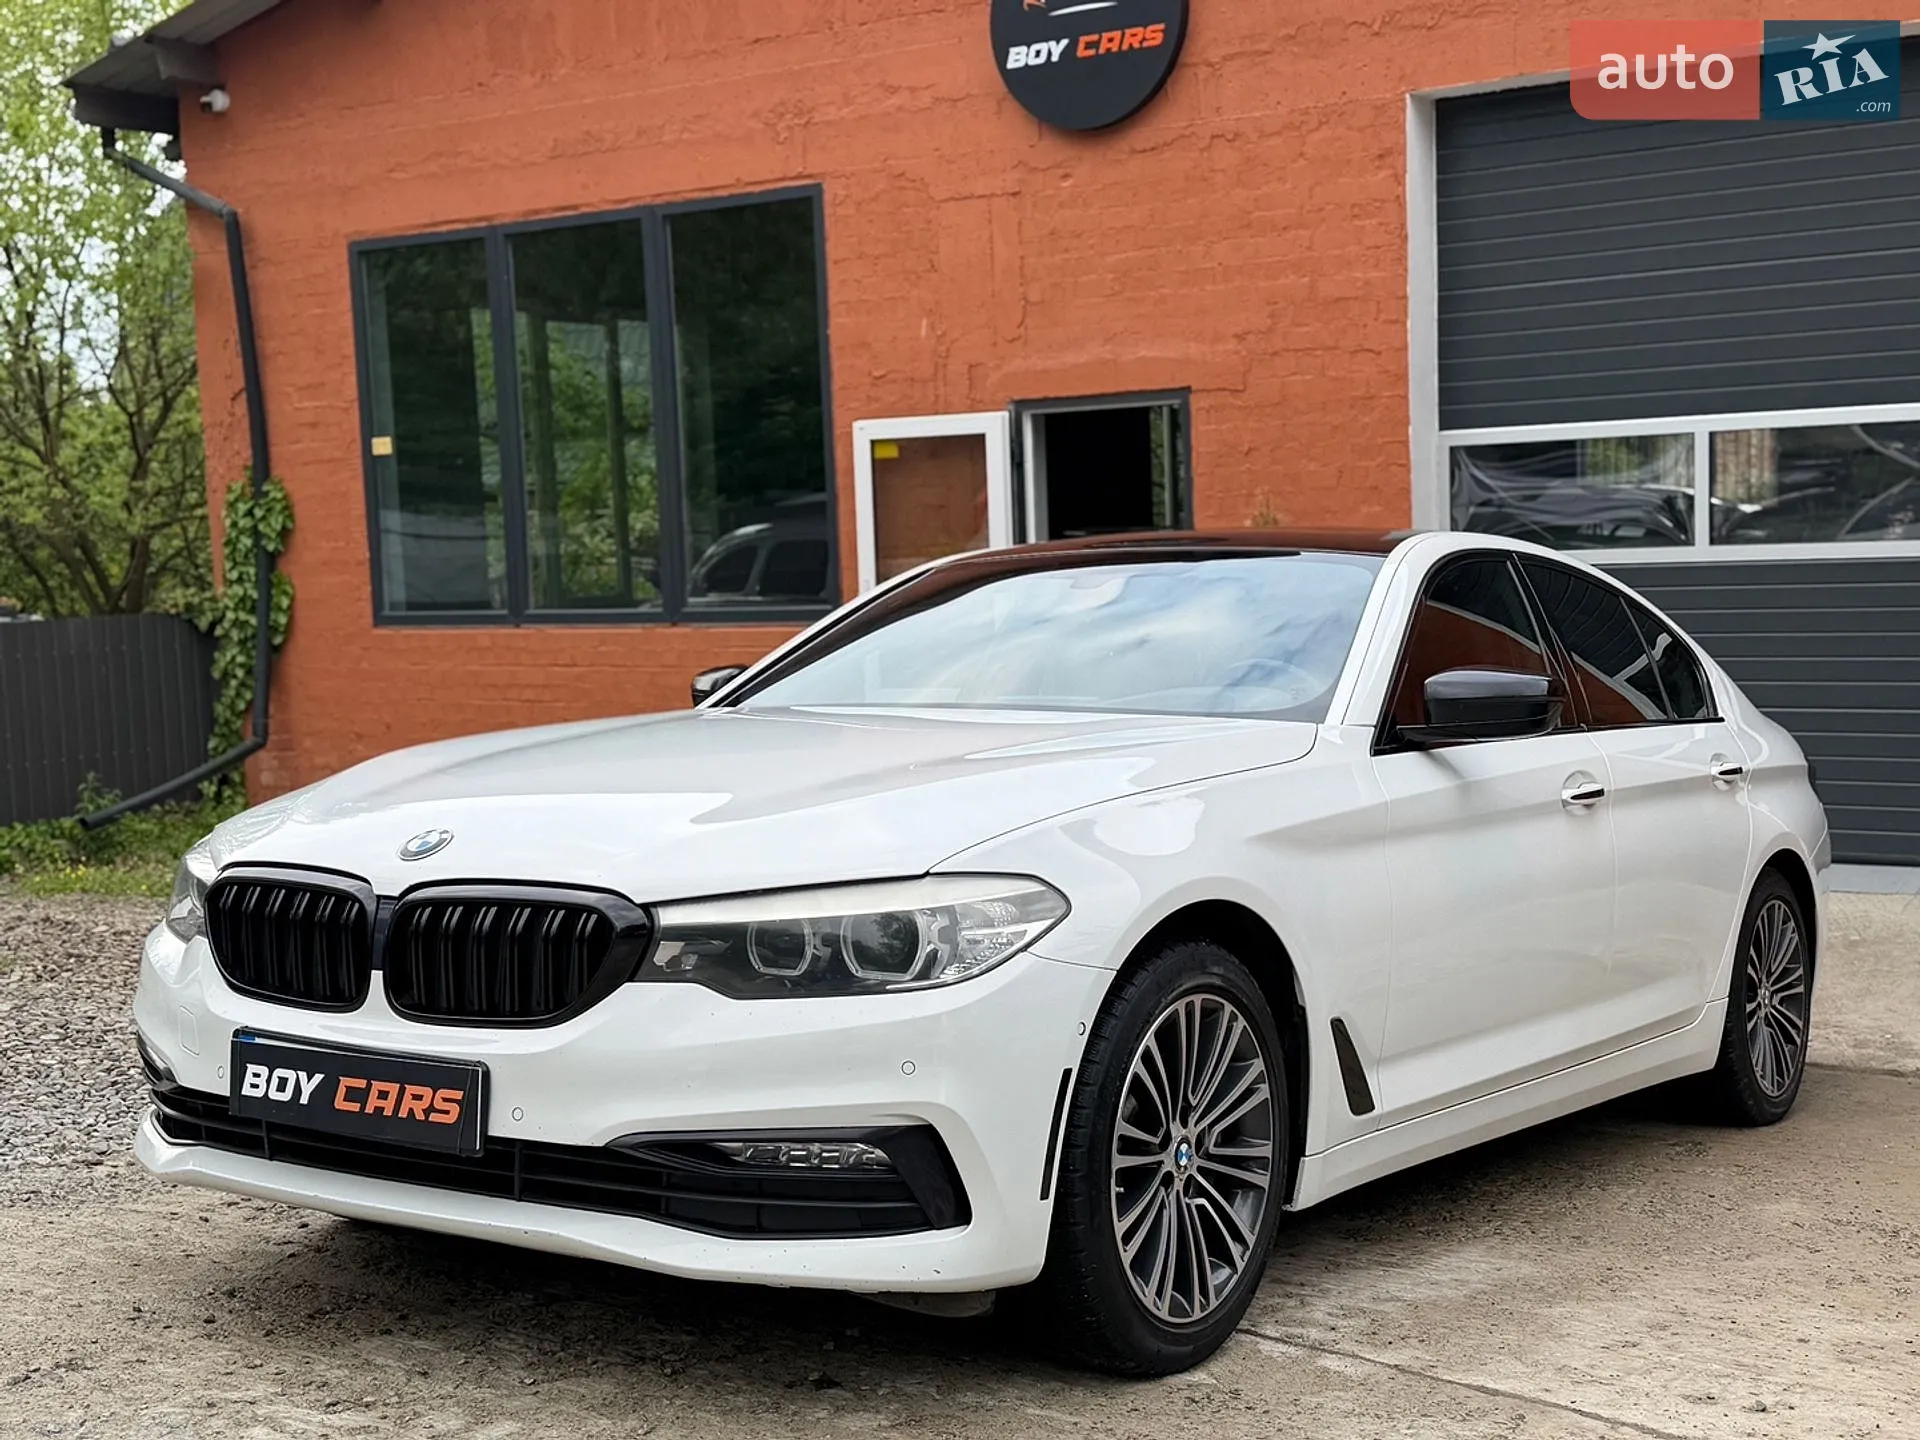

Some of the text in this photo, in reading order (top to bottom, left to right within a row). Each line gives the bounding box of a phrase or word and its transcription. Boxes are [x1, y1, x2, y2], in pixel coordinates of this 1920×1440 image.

[1006, 23, 1165, 69] BOY CARS
[240, 1063, 464, 1124] BOY CARS
